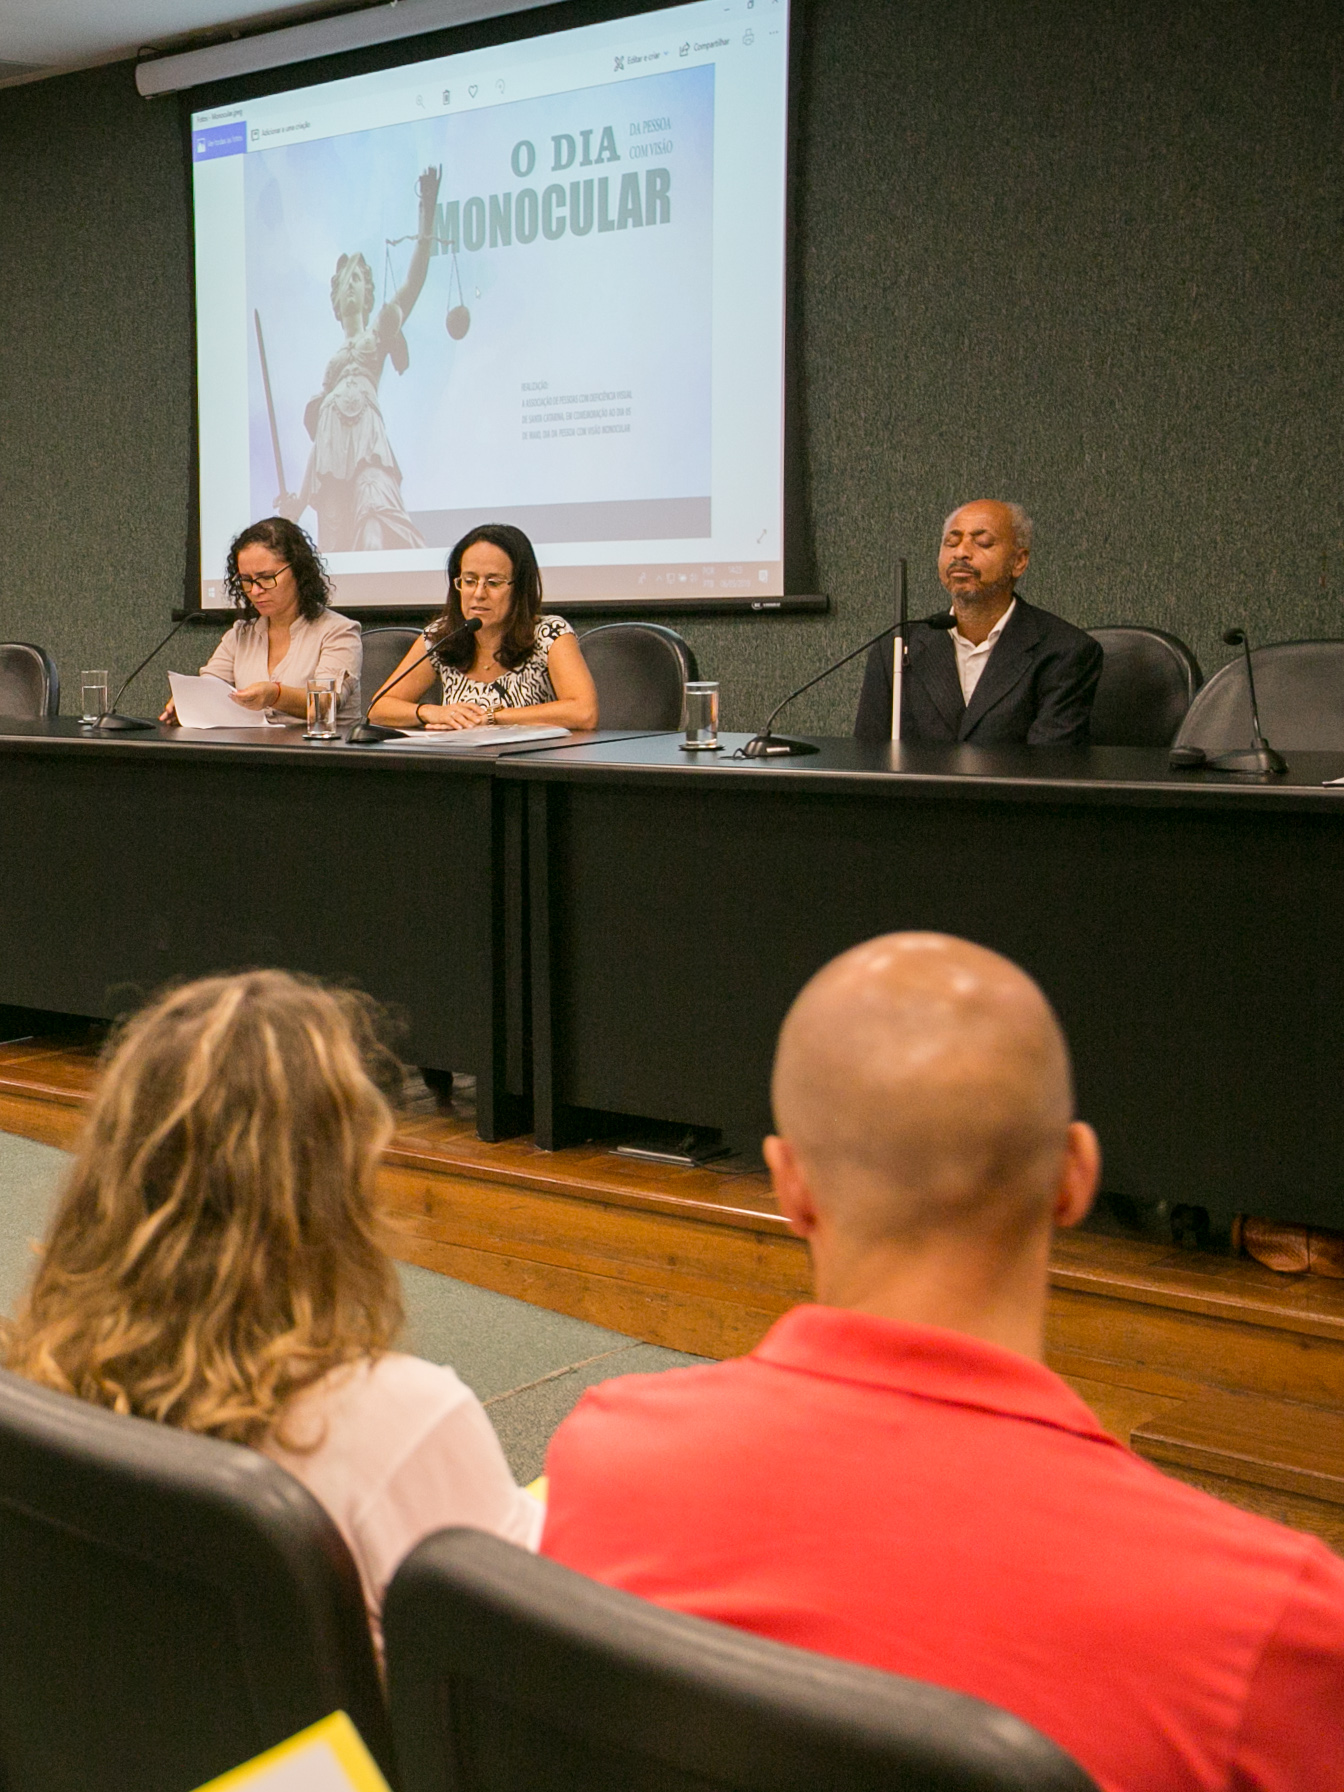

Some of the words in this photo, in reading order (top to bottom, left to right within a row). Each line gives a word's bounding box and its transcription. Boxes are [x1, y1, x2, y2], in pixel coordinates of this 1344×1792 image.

[694, 38, 730, 51] Compartilhar
[629, 123, 641, 136] DA
[643, 117, 671, 134] PESSOA
[511, 140, 536, 178] O
[551, 125, 621, 172] DIA
[629, 145, 648, 159] COM
[649, 139, 673, 156] VISÃO
[430, 168, 671, 256] MONOCULAR
